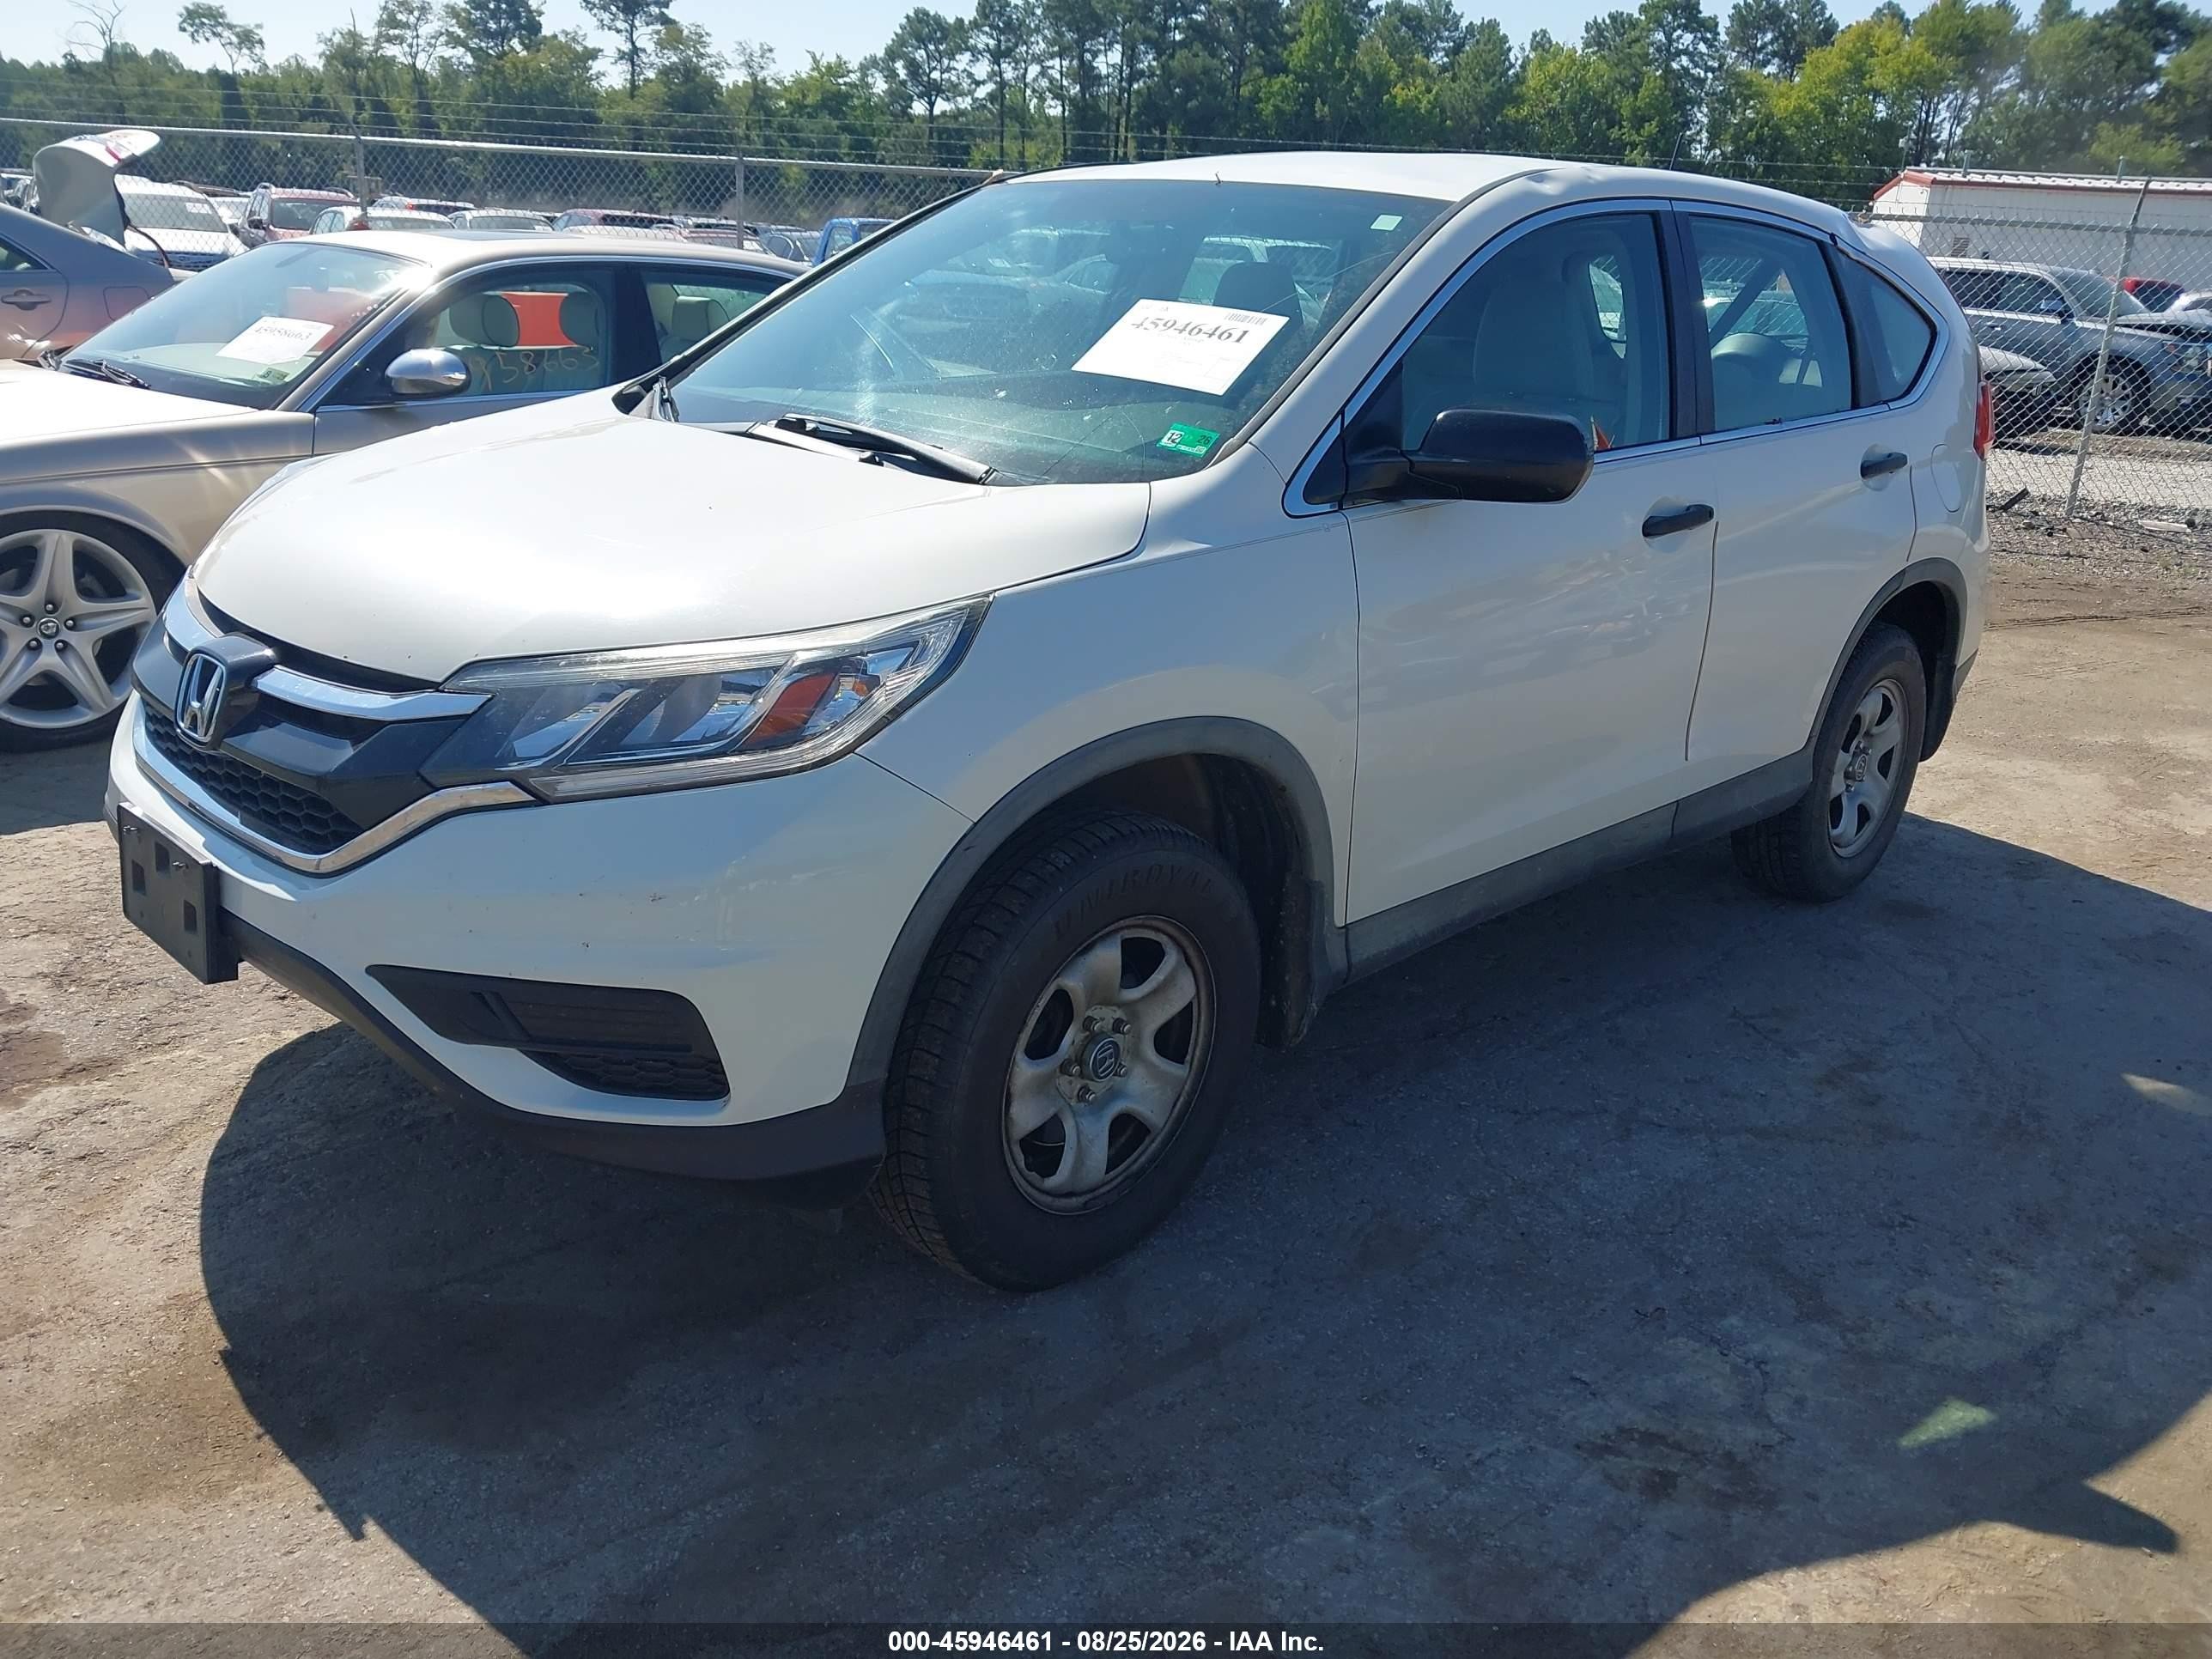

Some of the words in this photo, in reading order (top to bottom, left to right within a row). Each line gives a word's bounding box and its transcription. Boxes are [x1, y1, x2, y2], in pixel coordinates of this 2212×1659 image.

[1130, 316, 1250, 343] 45946461
[1166, 431, 1183, 444] 12
[1196, 434, 1212, 445] 26
